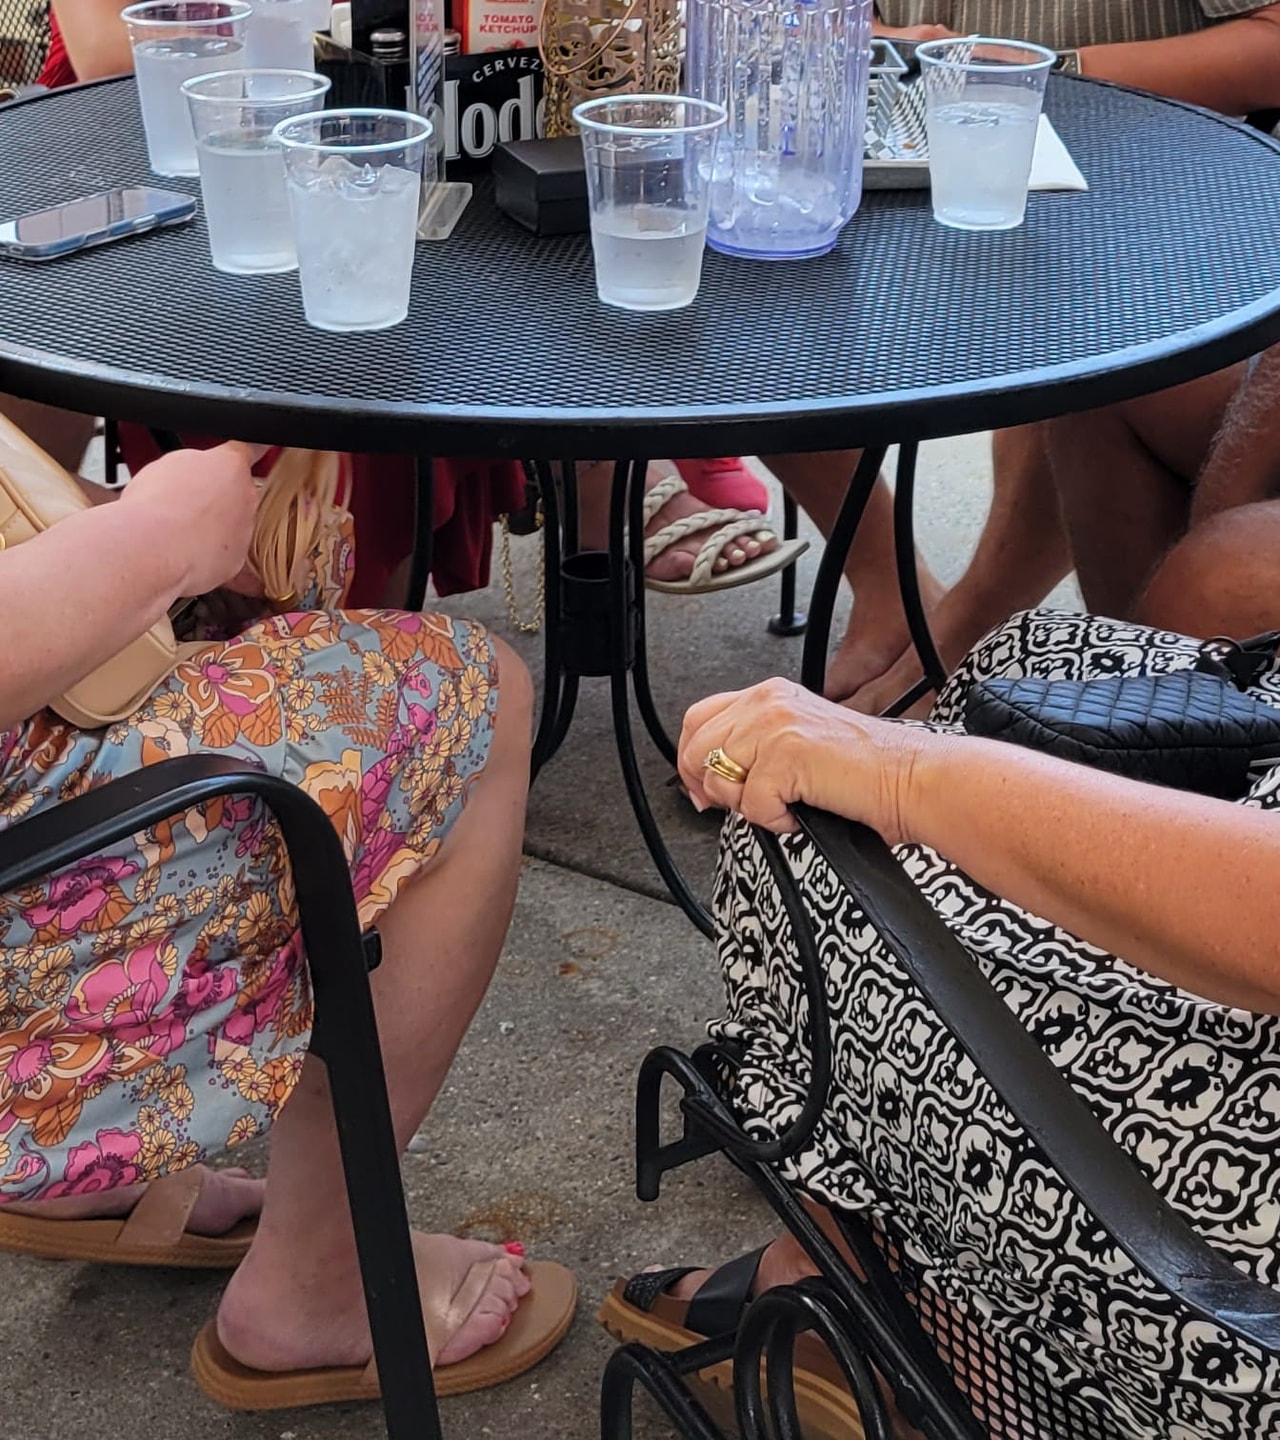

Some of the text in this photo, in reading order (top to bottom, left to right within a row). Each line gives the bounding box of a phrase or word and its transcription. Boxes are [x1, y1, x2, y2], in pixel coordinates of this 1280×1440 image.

[483, 14, 534, 24] TOMATO
[479, 24, 538, 34] KETCHUP
[472, 56, 545, 83] CERVEZ
